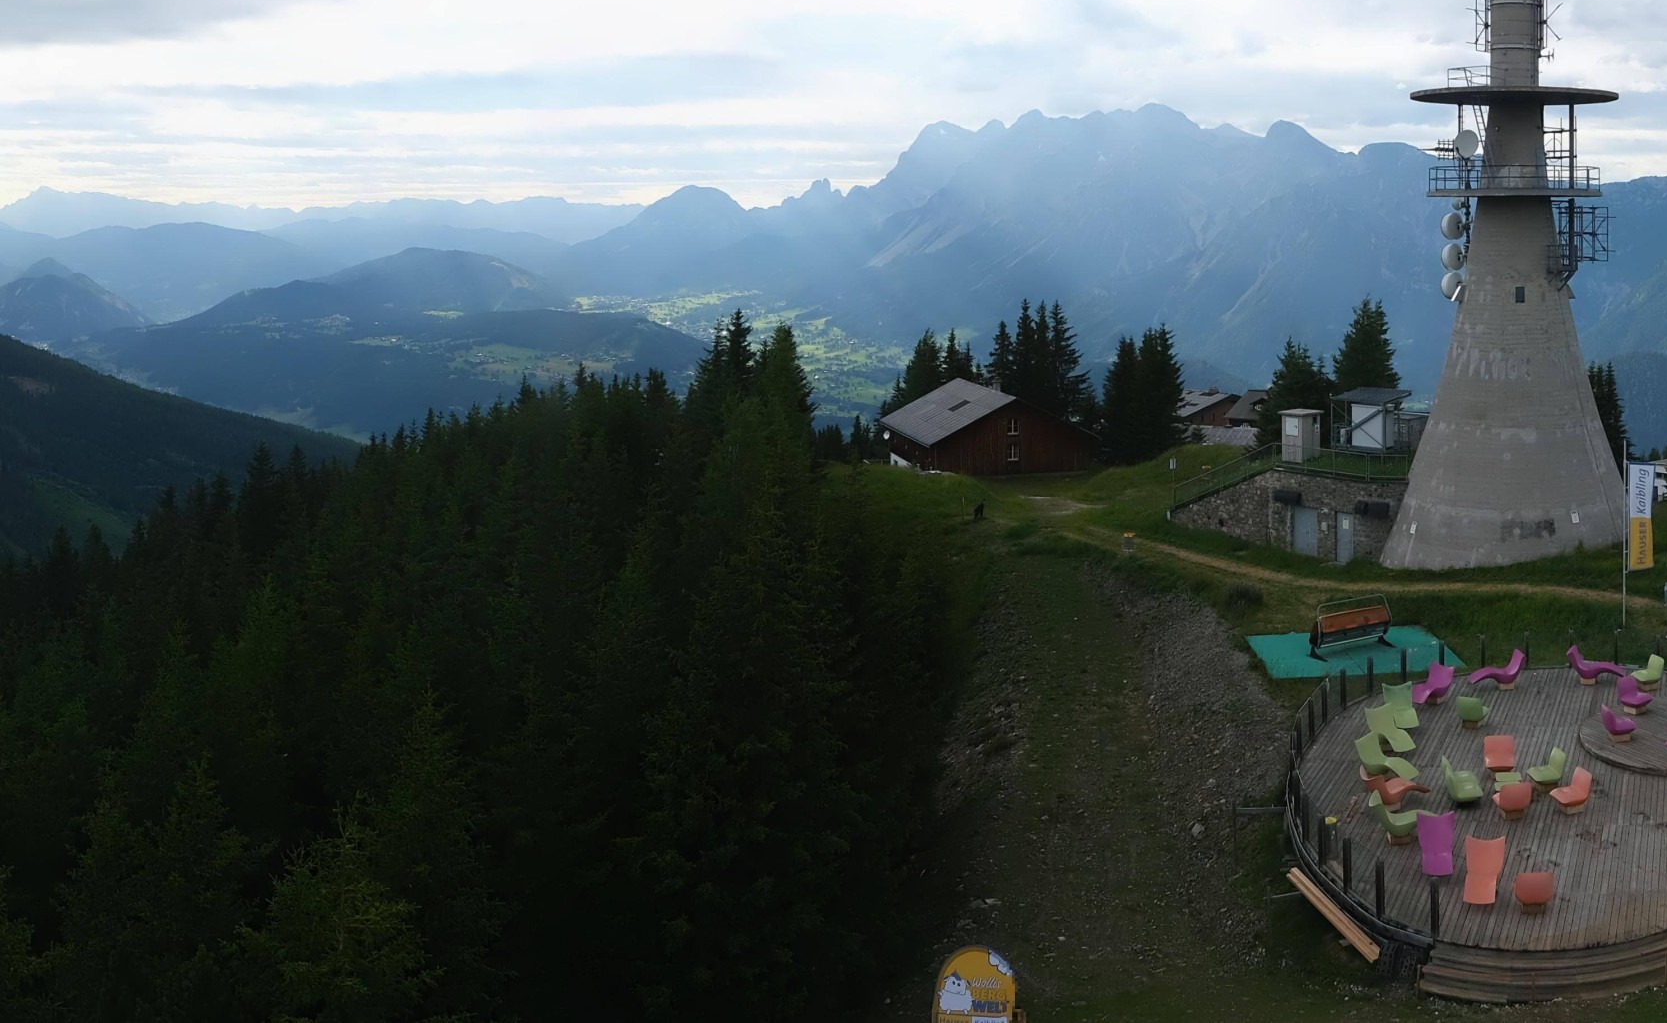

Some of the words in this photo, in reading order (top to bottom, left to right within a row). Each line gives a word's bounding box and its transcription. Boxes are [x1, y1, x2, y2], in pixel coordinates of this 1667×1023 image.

[1635, 468, 1650, 515] Kaibling
[1636, 521, 1647, 565] HAUSER
[972, 988, 1007, 1000] BERG
[972, 1000, 1007, 1013] WELT
